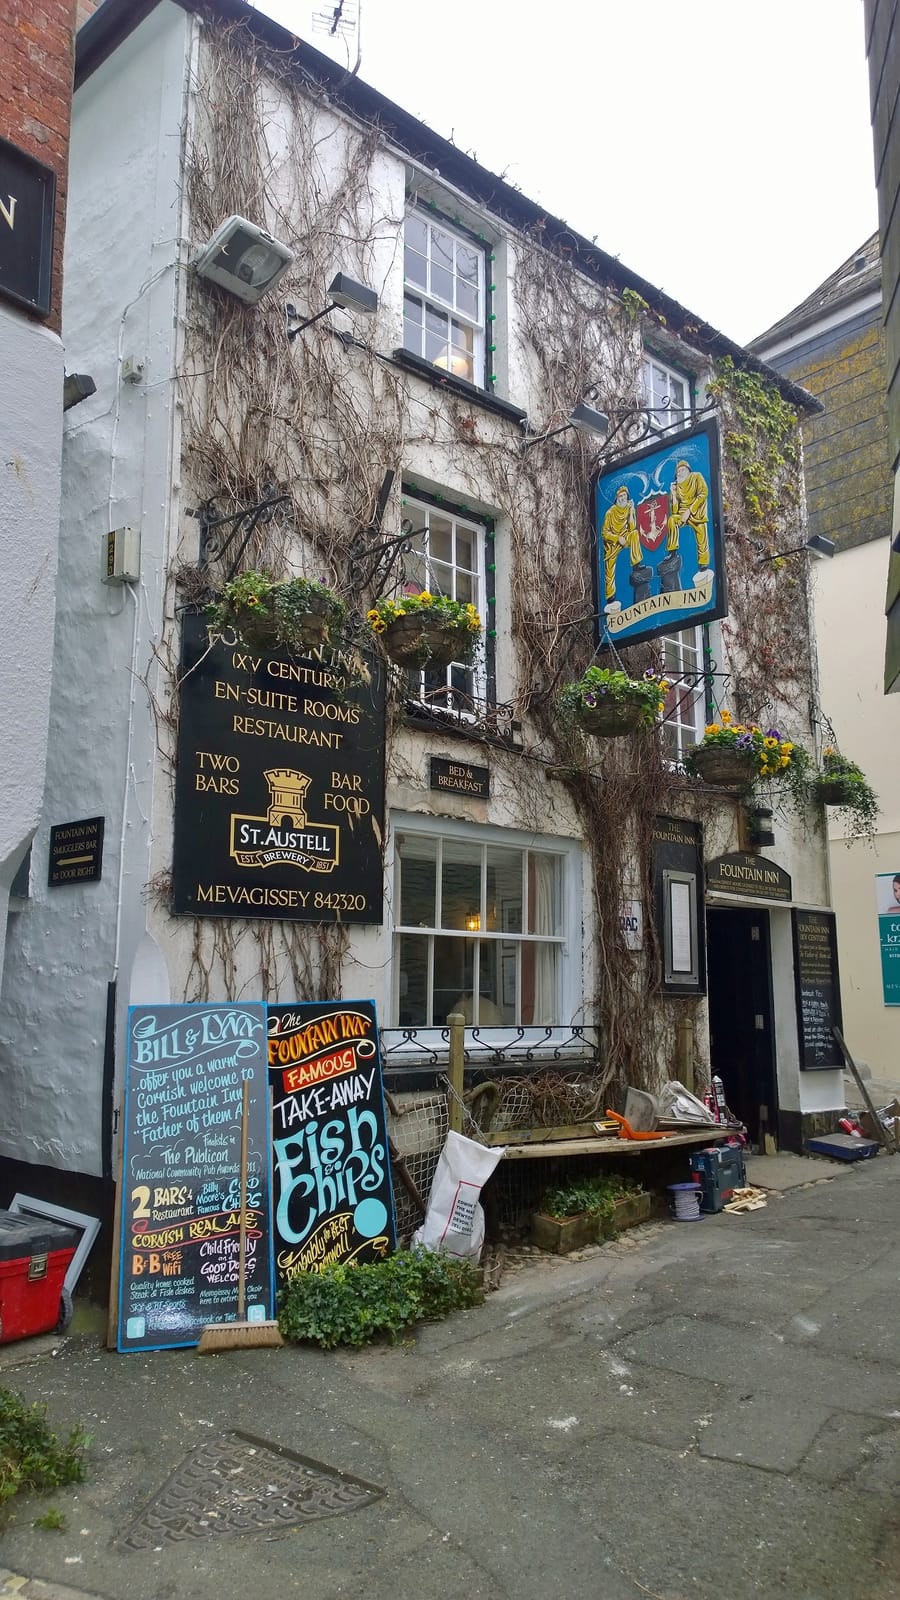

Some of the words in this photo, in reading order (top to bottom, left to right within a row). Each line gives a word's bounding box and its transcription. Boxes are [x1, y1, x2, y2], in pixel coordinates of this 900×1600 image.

[607, 595, 672, 628] FOUNTAIN
[683, 588, 707, 605] INN
[267, 661, 346, 689] CENTURY)
[214, 681, 299, 713] EN-SUITE
[304, 700, 360, 725] ROOMS
[233, 715, 343, 750] RESTAURANT
[196, 752, 240, 773] TWO
[449, 765, 465, 777] BED
[466, 769, 473, 779] &
[195, 775, 240, 795] BARS
[331, 772, 364, 792] BAR
[438, 775, 483, 792] BREAKFAST
[324, 793, 370, 815] FOOD
[55, 826, 86, 840] FOUNTAIN
[86, 824, 98, 835] INN
[668, 822, 680, 832] THE
[53, 842, 86, 855] SMUGGLERS
[86, 840, 97, 849] BAR
[652, 831, 682, 843] FOUNTAIN
[683, 835, 695, 845] INN
[240, 854, 258, 865] EST.
[263, 851, 310, 866] BREWERY
[316, 861, 330, 870] 1851
[744, 856, 755, 866] THE
[61, 869, 76, 879] DOOR
[720, 863, 763, 882] FOUNTAIN
[764, 871, 779, 884] INN
[197, 884, 311, 908] MEVAGISSEY
[313, 891, 366, 911] 842320
[282, 1012, 301, 1030] The
[134, 1029, 193, 1063] BILL
[186, 1028, 200, 1046] &
[201, 1012, 263, 1045] LYNN
[268, 1015, 340, 1065] FOUNTAIN
[340, 1014, 371, 1038] INN
[172, 1067, 193, 1085] you
[196, 1063, 205, 1075] a
[207, 1055, 238, 1073] warm
[287, 1051, 353, 1088] FAMOUS
[138, 1085, 186, 1109] Cornish
[190, 1074, 239, 1095] welcome
[241, 1067, 254, 1080] to
[273, 1067, 376, 1129] TAKE-AWAY
[136, 1110, 159, 1127] the
[162, 1094, 219, 1121] Fountain
[221, 1088, 243, 1104] Inn
[186, 1115, 199, 1133] of
[202, 1108, 233, 1128] them
[273, 1105, 378, 1178] Fish
[160, 1148, 180, 1164] The
[185, 1146, 229, 1164] Publican
[136, 1168, 165, 1180] National
[166, 1167, 201, 1178] Community
[203, 1164, 216, 1175] Pub
[216, 1163, 240, 1174] Awards
[196, 1192, 225, 1205] Moore's
[202, 1182, 219, 1194] Billy
[276, 1143, 385, 1244] Chips
[131, 1185, 151, 1219] 2
[153, 1186, 187, 1207] BARS
[197, 1204, 220, 1215] Famous
[152, 1205, 195, 1221] Restaurant
[132, 1227, 184, 1248] CORNISH
[189, 1218, 232, 1238] REAL
[329, 1215, 351, 1241] BEST
[162, 1250, 183, 1261] FREE
[199, 1239, 222, 1256] Child
[223, 1236, 257, 1257] Friely
[163, 1261, 182, 1276] Wifi
[200, 1261, 227, 1275] GOOD
[227, 1258, 257, 1272] DOS
